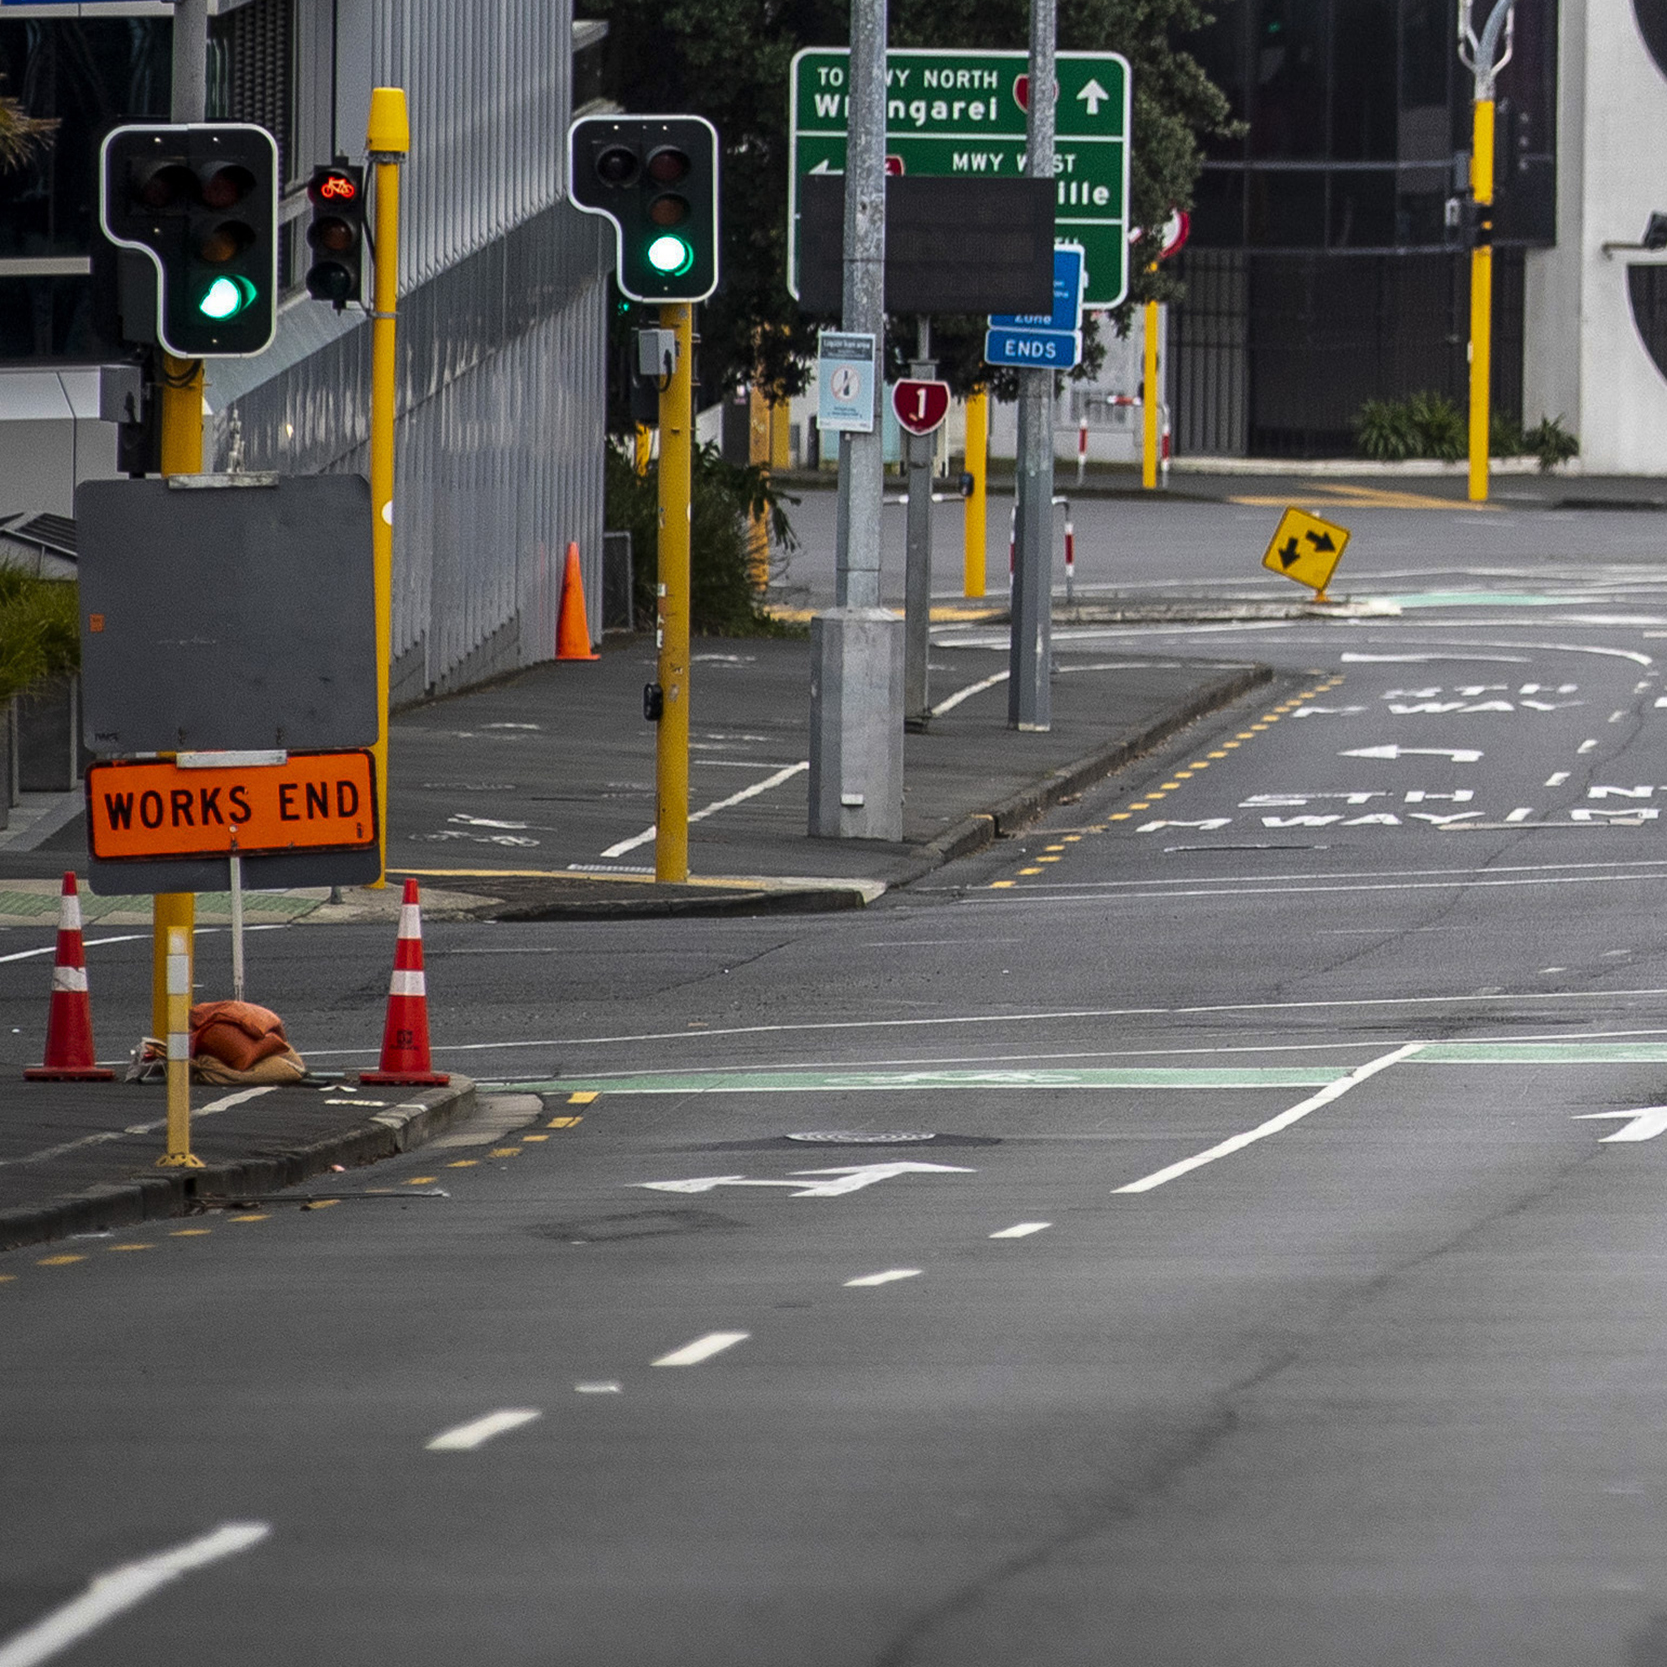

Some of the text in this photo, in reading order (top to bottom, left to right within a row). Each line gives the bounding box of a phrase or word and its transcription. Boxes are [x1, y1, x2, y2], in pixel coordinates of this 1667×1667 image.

[817, 67, 843, 86] TO
[924, 69, 998, 89] NORTH
[815, 93, 998, 127] Wngarei
[953, 153, 1077, 174] MWY WST
[1005, 339, 1056, 359] ENDS
[105, 780, 360, 831] WORKS END
